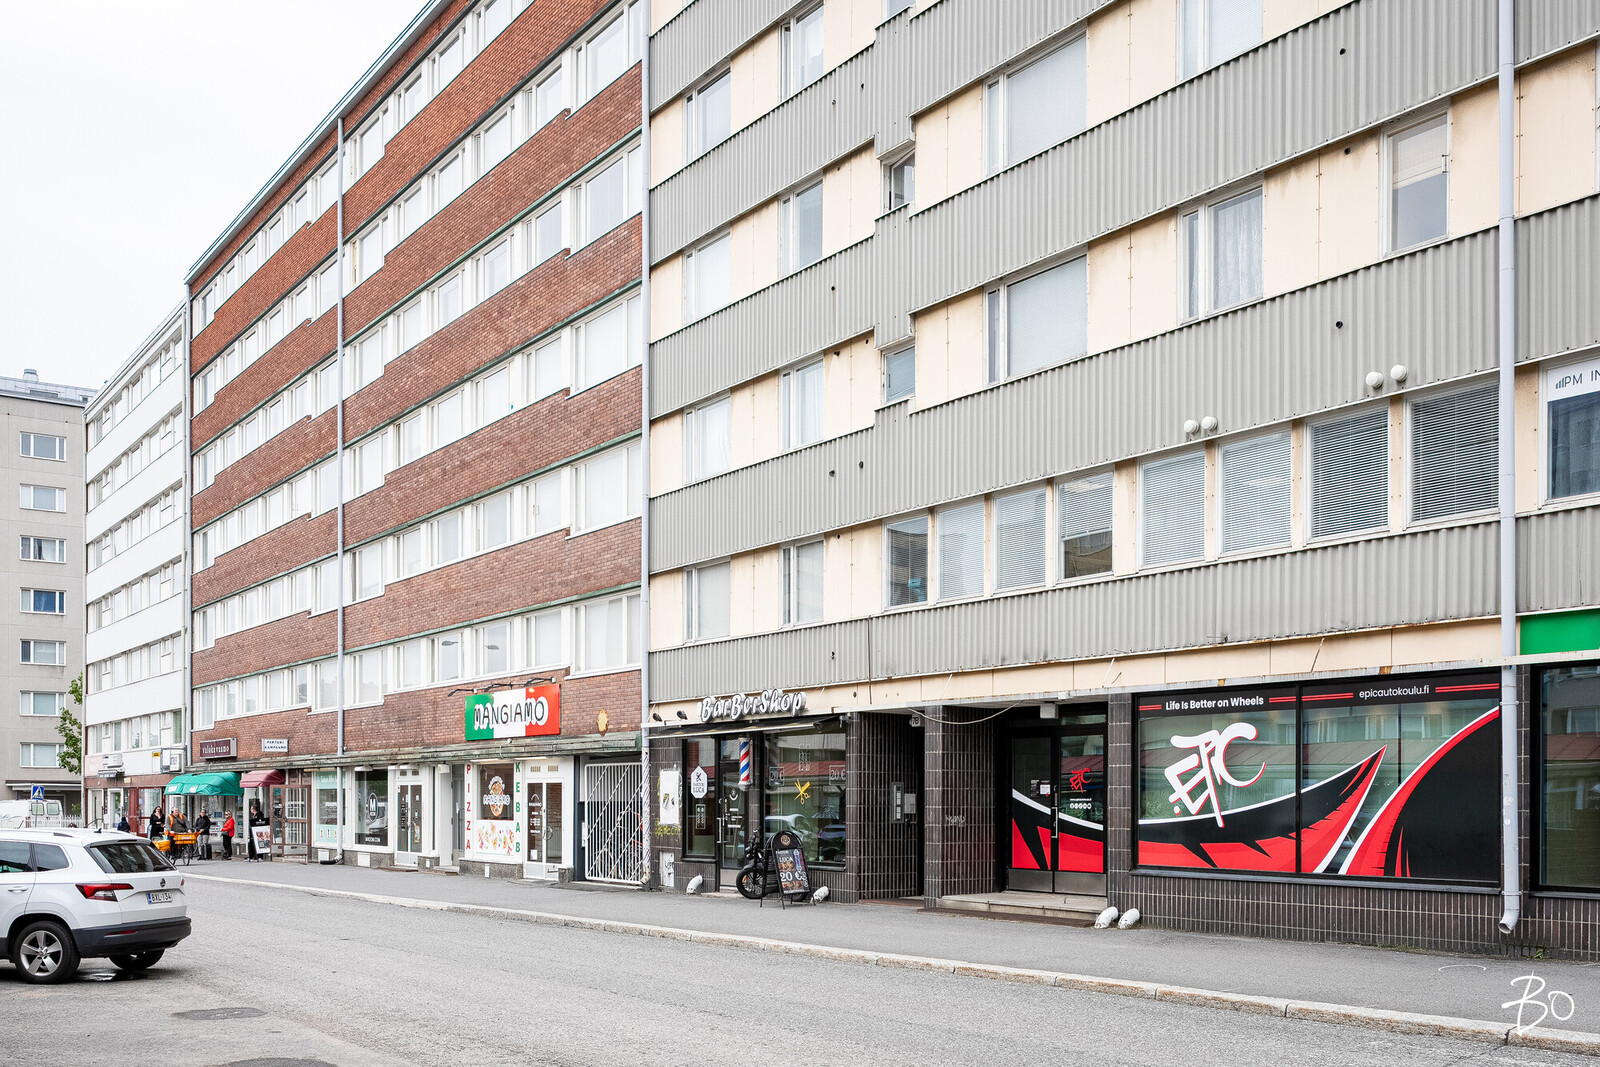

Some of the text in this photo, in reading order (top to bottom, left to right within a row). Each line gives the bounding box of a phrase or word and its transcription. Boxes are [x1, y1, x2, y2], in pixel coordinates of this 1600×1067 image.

[1564, 373, 1583, 388] PM
[1359, 684, 1430, 700] epicautokoulu.fi
[1165, 695, 1264, 711] Life Is Better on Wheels
[474, 697, 548, 730] MANGIAMO
[779, 871, 793, 882] 20
